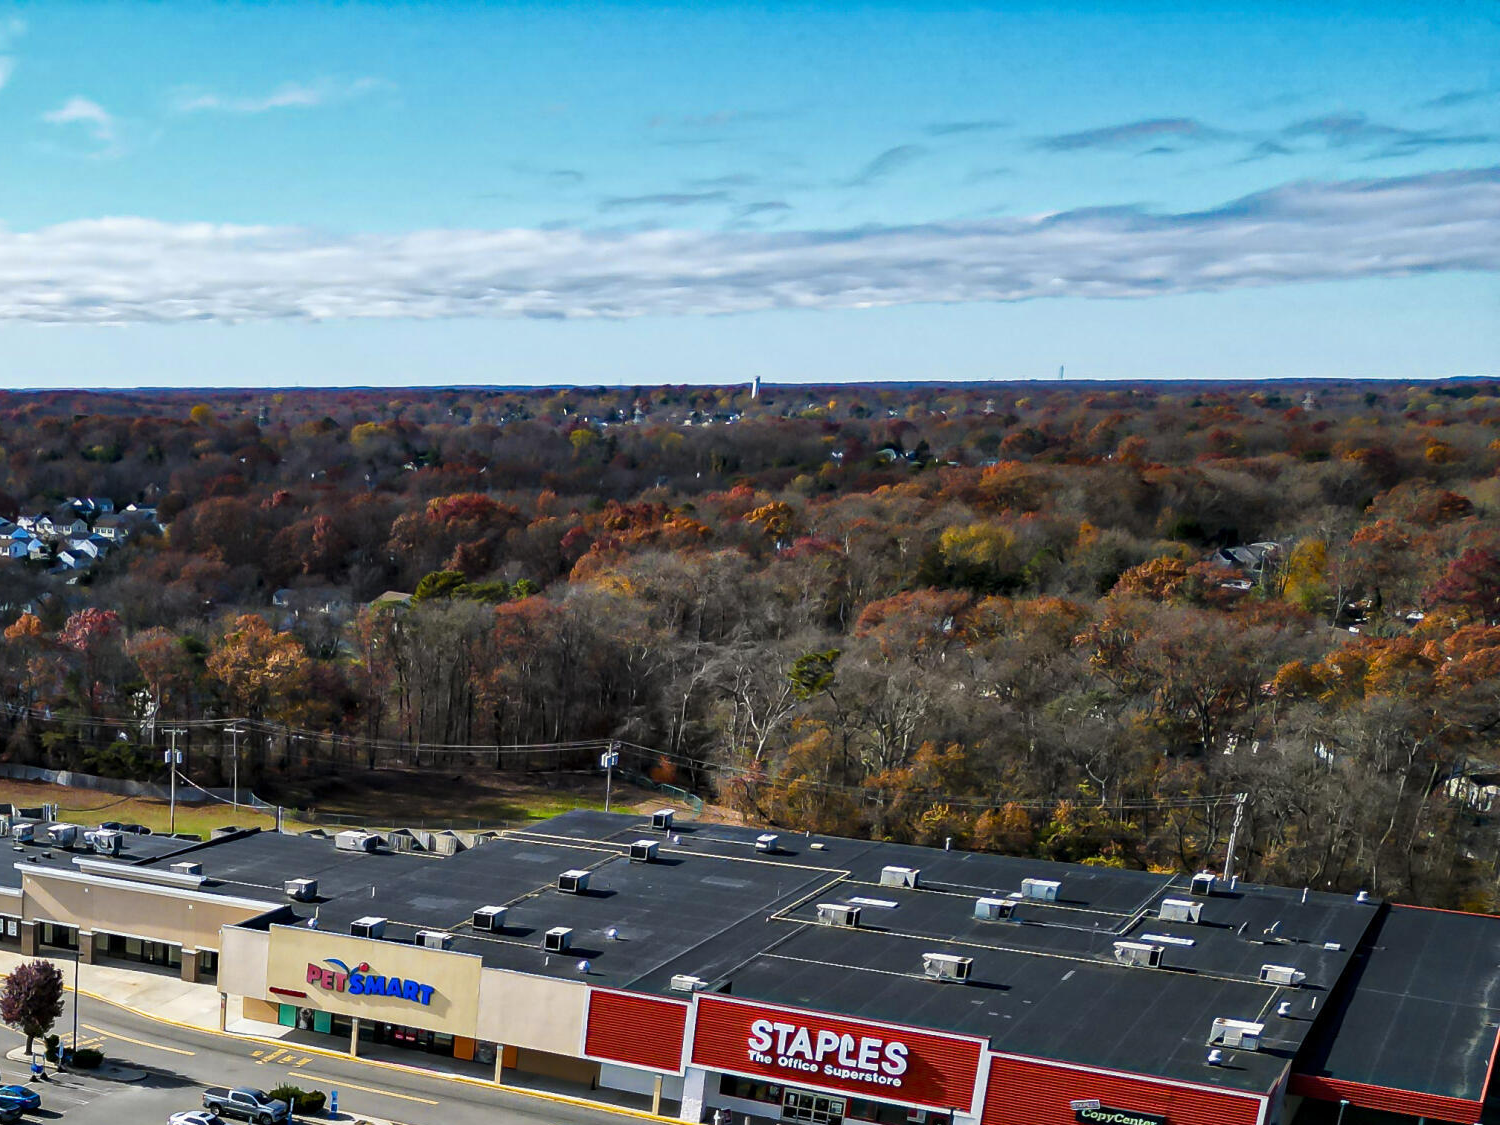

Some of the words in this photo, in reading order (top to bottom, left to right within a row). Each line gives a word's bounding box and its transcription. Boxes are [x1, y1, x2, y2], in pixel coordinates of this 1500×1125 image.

[748, 1019, 909, 1076] STAPLES
[748, 1049, 773, 1065] The
[778, 1056, 819, 1073] Office
[823, 1064, 902, 1087] Superstore
